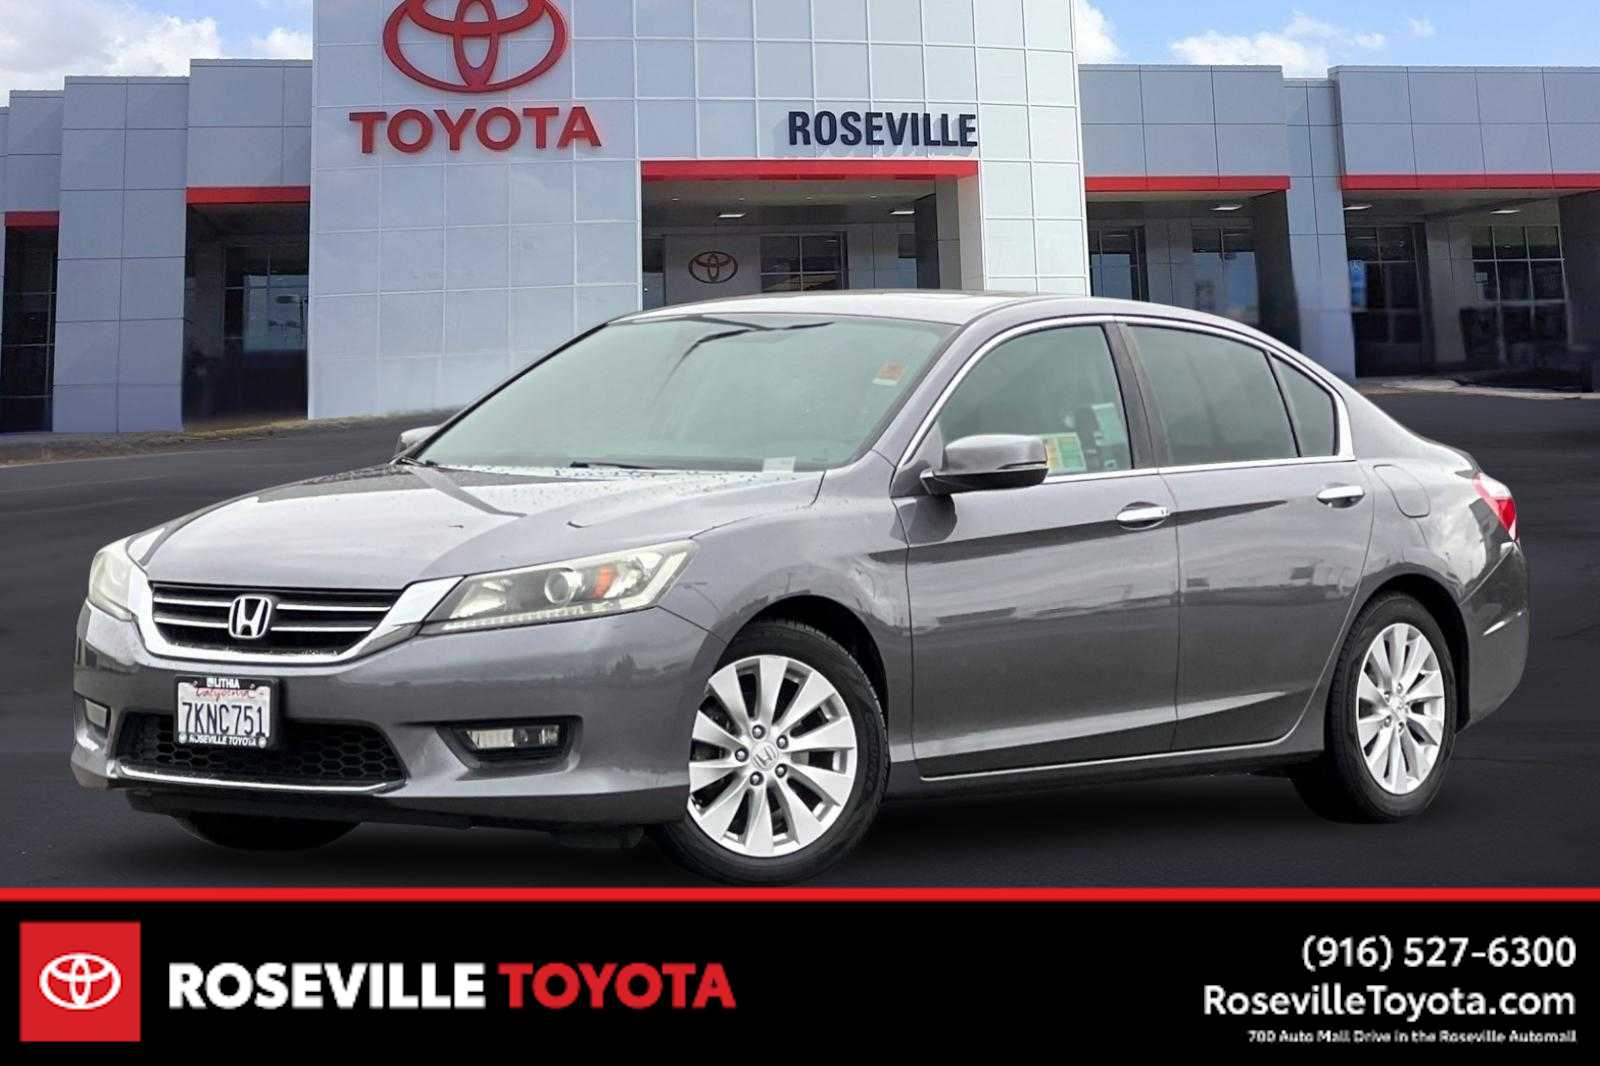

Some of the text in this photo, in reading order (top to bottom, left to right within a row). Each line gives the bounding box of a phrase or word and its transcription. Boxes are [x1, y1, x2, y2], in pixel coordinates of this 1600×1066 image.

[349, 106, 602, 154] TOYOTA
[788, 110, 978, 147] ROSEVILLE
[182, 702, 266, 737] 7KNC751
[188, 734, 257, 747] ROSEVILLE TOYOTA
